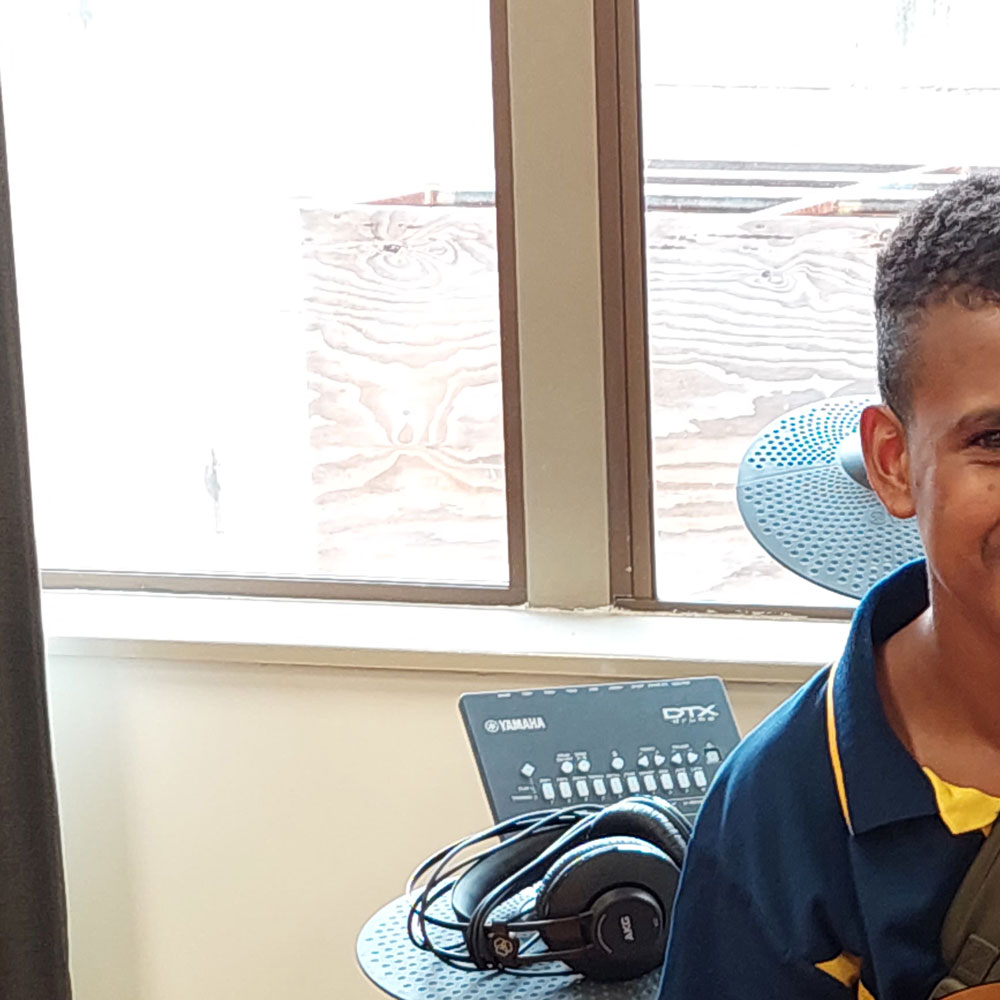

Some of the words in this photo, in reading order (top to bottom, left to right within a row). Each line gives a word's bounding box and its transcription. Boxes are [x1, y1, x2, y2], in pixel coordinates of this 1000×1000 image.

[662, 704, 719, 720] DTX
[499, 716, 546, 732] YAMAHA
[621, 915, 635, 941] AKG
